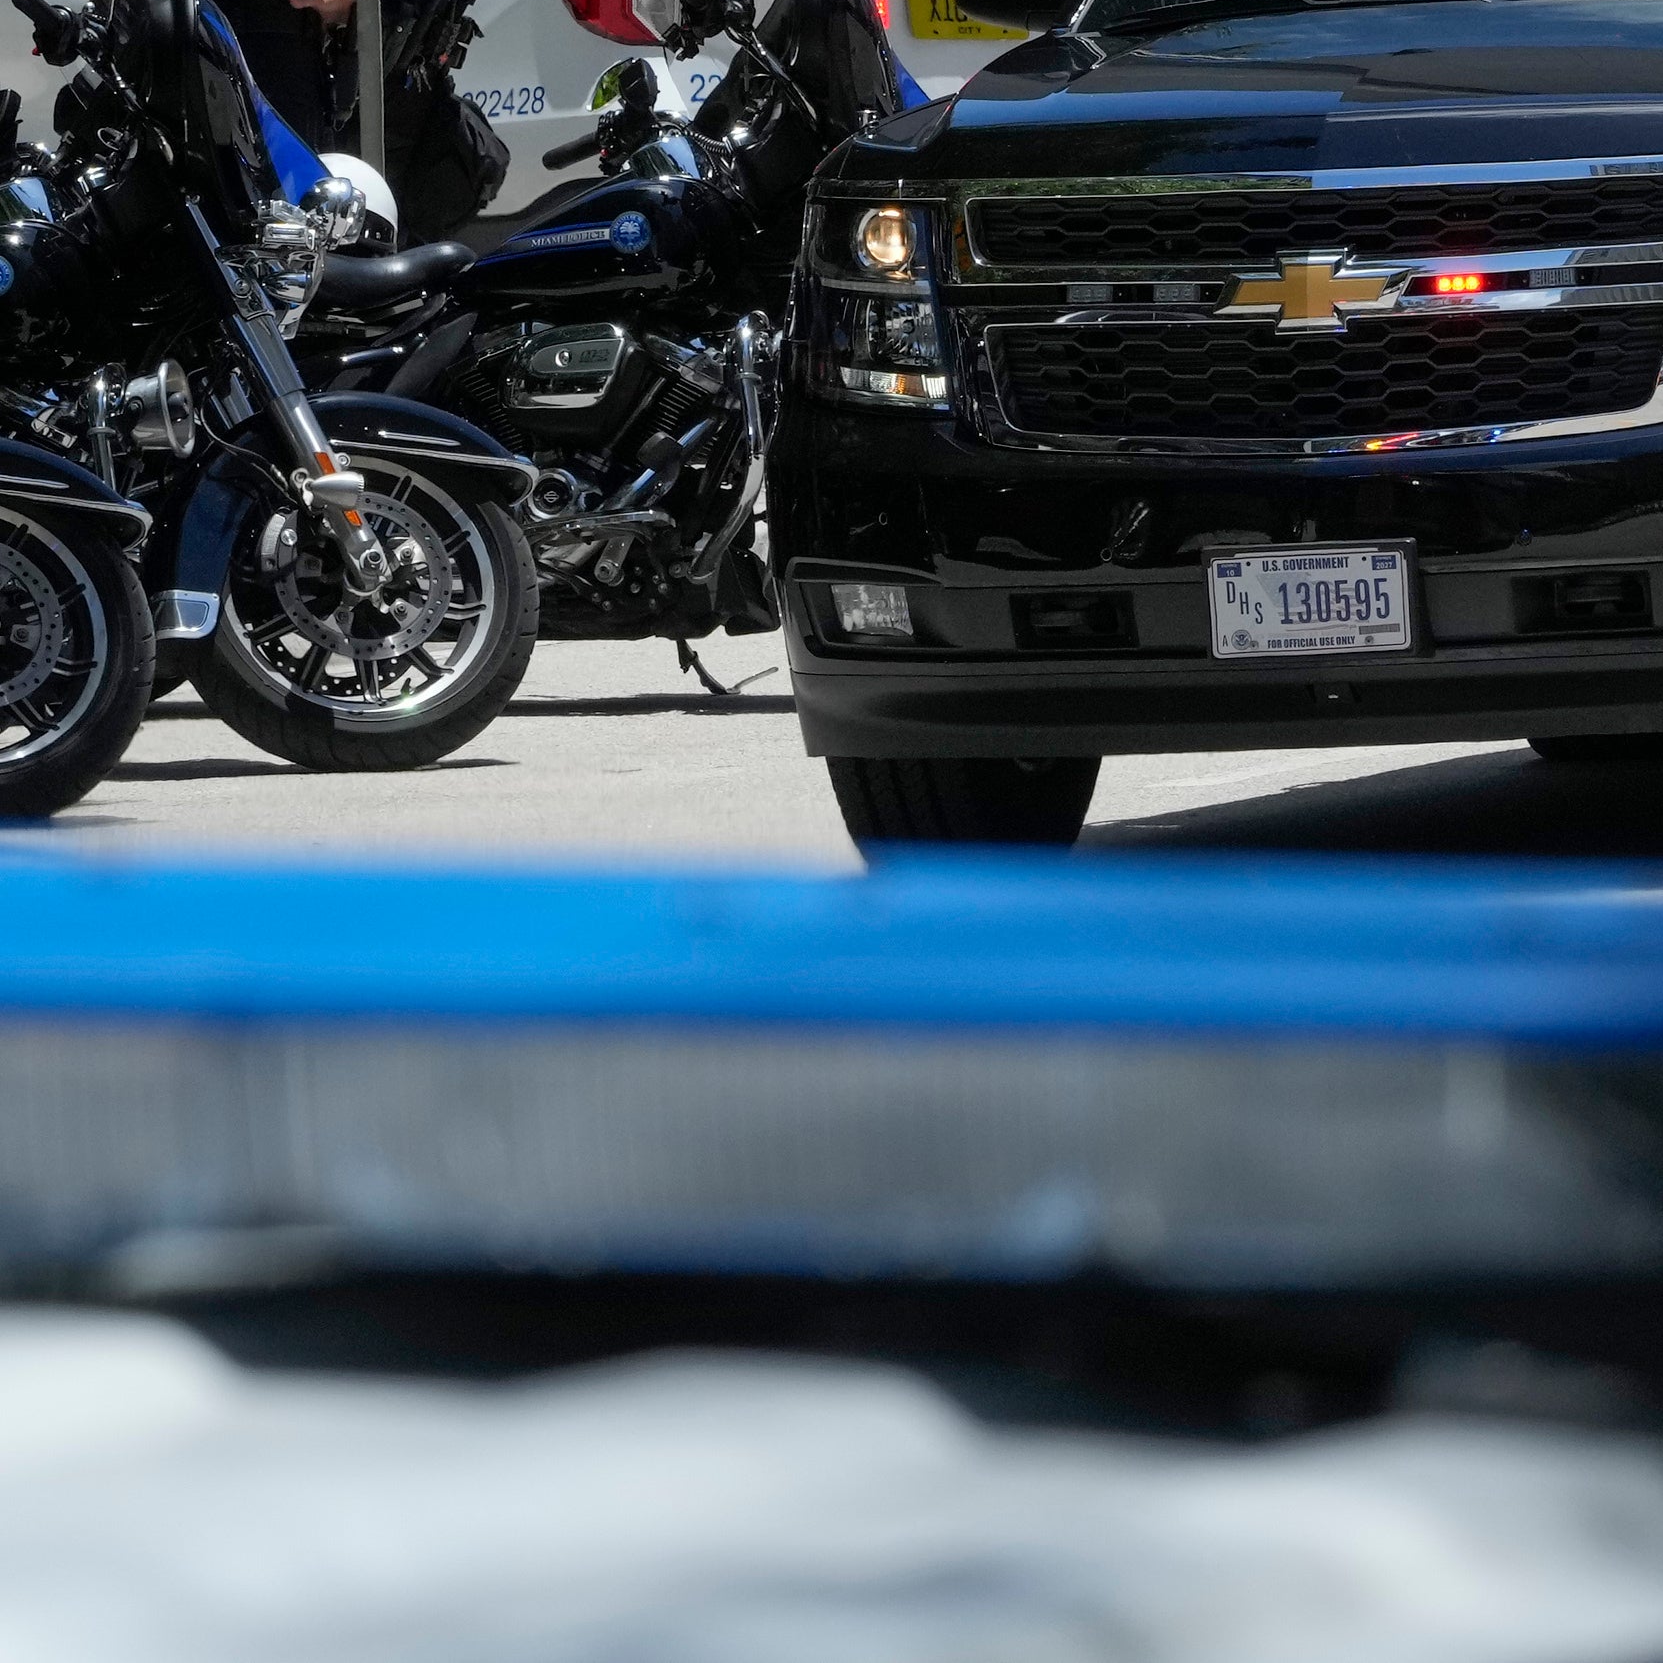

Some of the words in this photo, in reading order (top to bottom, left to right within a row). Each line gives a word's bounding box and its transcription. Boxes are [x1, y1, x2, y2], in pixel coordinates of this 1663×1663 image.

[958, 27, 982, 35] CITY
[531, 237, 564, 247] MIAMI
[567, 231, 605, 242] POLICE
[1262, 560, 1281, 572] U.S.
[1283, 556, 1349, 571] GOVERNMENT
[1376, 562, 1393, 570] 2027
[1278, 578, 1390, 625] 130595
[1222, 635, 1228, 647] A
[1268, 639, 1282, 649] FOR
[1284, 637, 1317, 648] OFFICIAL
[1319, 636, 1335, 647] USE
[1336, 635, 1355, 645] ONLY
